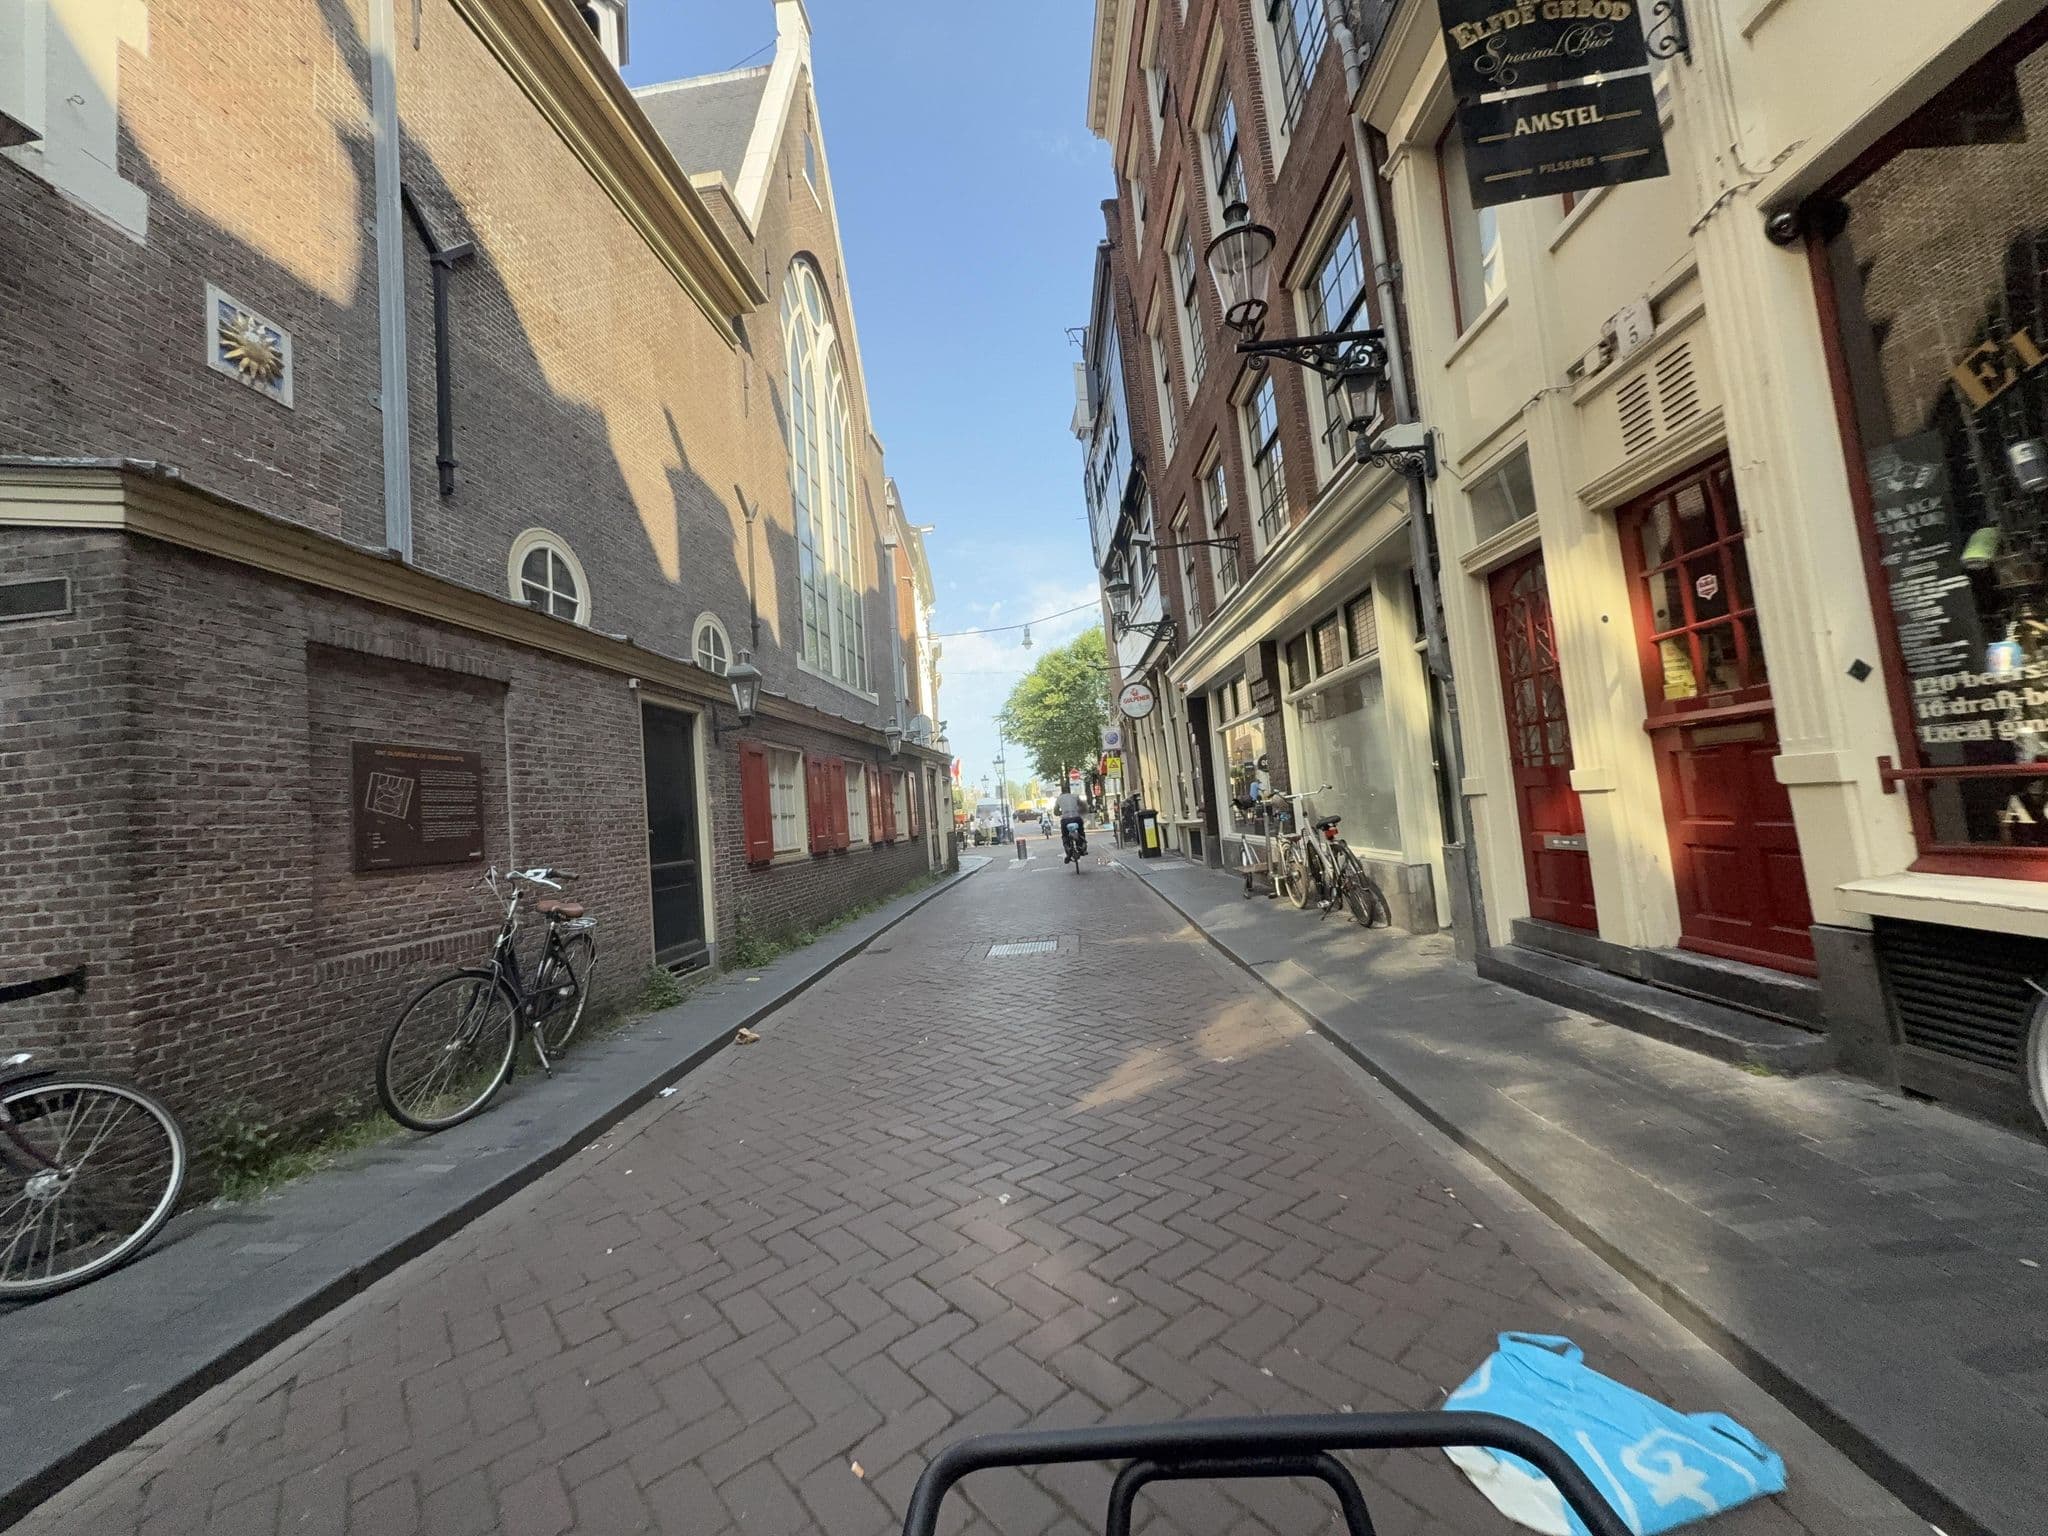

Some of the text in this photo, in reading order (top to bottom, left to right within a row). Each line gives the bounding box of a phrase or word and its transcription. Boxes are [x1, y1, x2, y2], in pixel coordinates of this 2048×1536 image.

[1448, 0, 1631, 50] ELFDE GEBOD
[1514, 105, 1603, 137] AMSTEL
[1539, 156, 1594, 174] PILSENER
